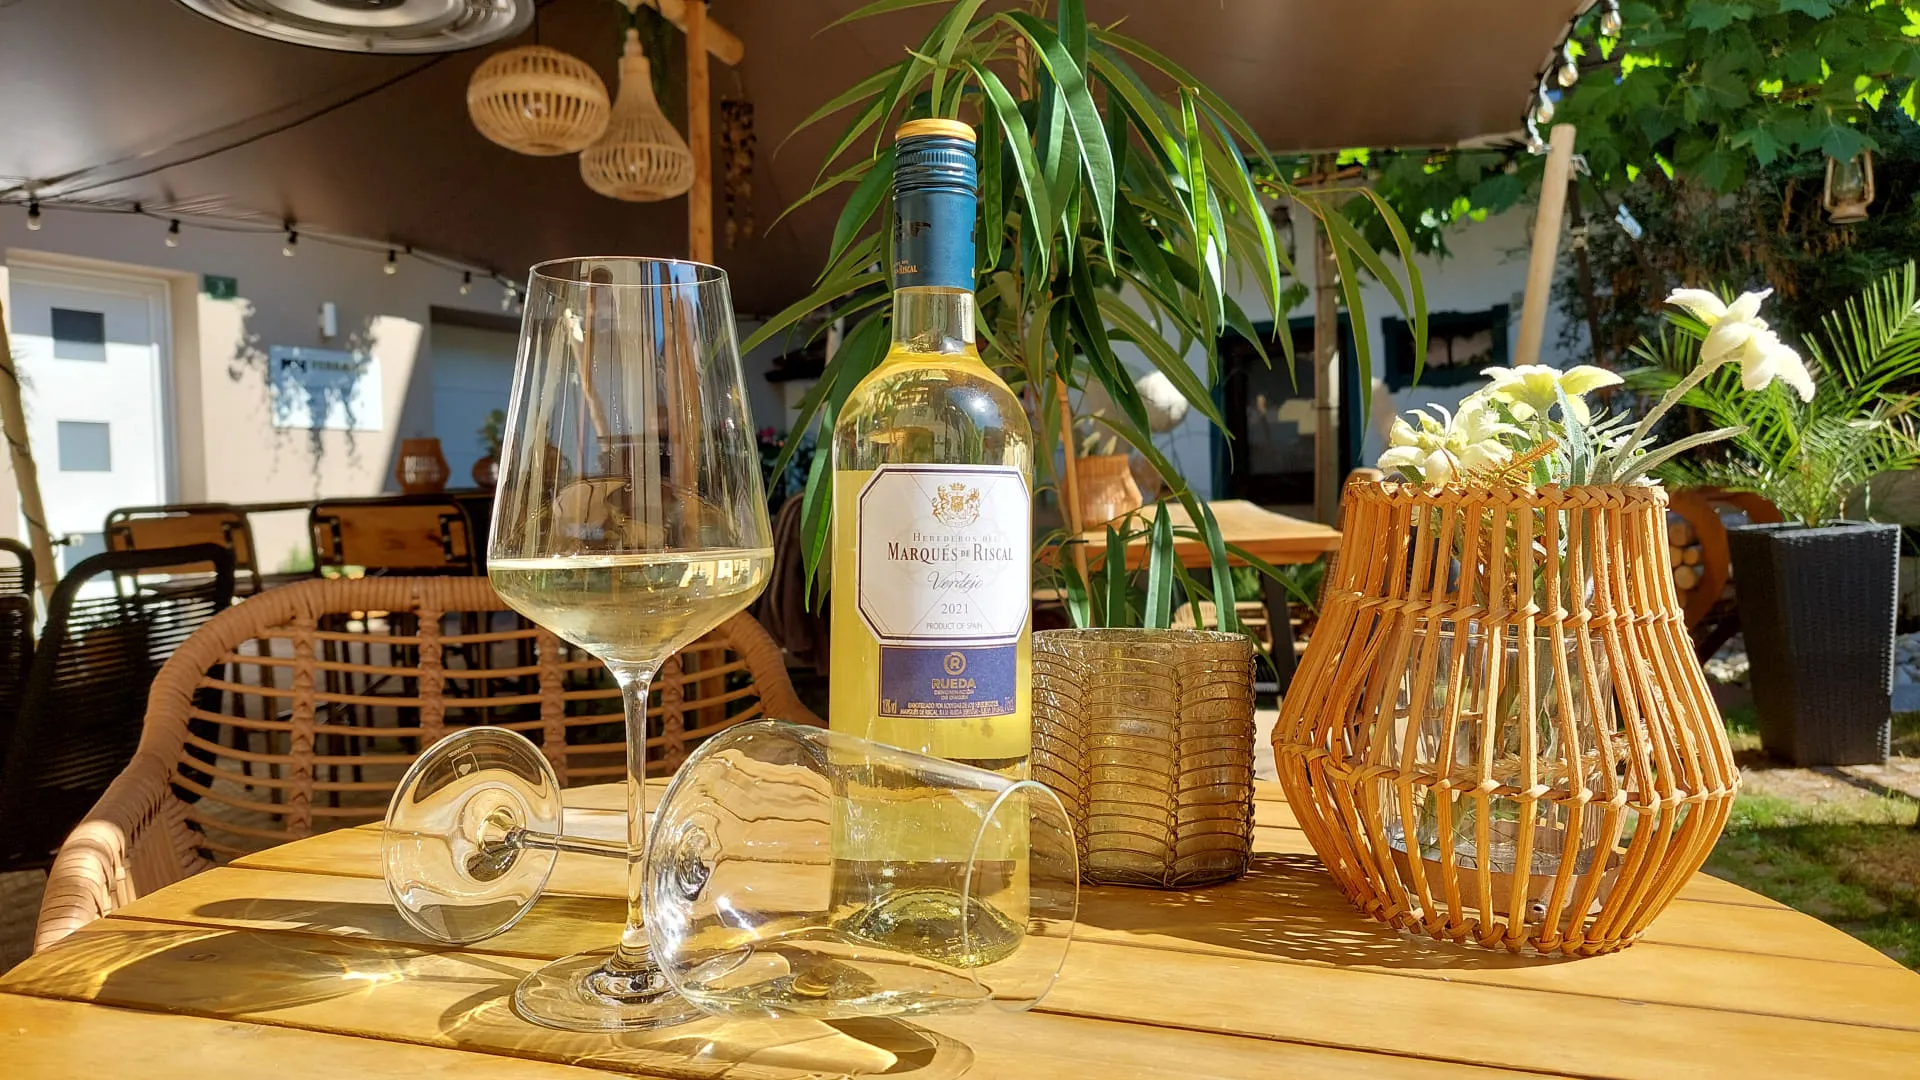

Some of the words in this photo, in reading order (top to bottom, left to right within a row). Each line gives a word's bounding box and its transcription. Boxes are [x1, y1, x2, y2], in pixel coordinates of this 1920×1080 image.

[888, 542, 958, 565] MARQUÉS
[973, 543, 1014, 561] RISCAL
[927, 570, 984, 594] Verdejo
[941, 603, 969, 615] 2021
[926, 622, 955, 630] PRODUCT
[956, 622, 965, 630] OF
[966, 622, 983, 630] SPAIN
[931, 678, 976, 689] RUEDA
